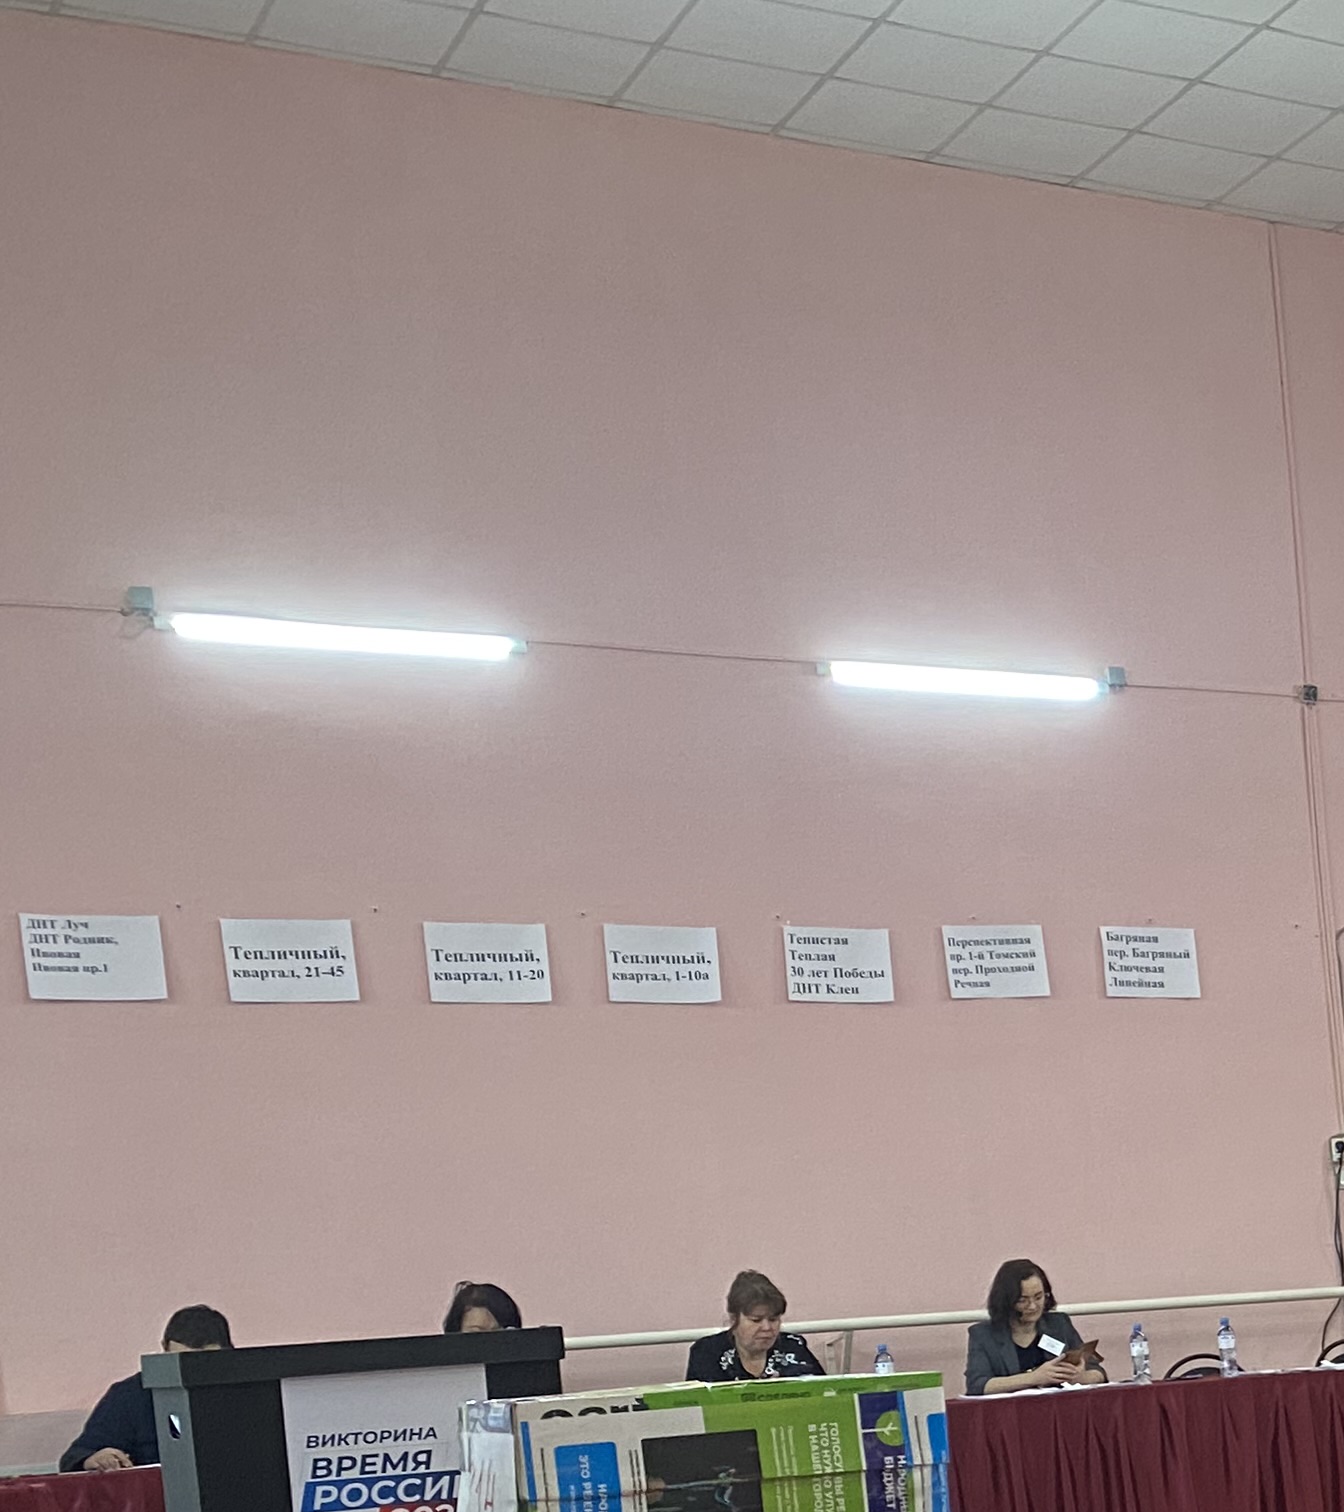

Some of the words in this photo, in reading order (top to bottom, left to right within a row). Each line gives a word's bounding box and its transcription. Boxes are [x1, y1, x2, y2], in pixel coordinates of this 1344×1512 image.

[26, 918, 57, 929] ДНТ
[61, 919, 90, 932] Луч
[28, 933, 60, 945] ДНТ
[787, 933, 849, 946] Тенистая
[1106, 931, 1159, 945] Багряная
[228, 945, 347, 961] Тепличный,
[430, 948, 541, 963] Тепличный,
[609, 950, 712, 965] Тепличный,
[789, 949, 836, 962] Теплая
[986, 949, 1037, 960] Томский
[1107, 949, 1129, 960] пер.
[1132, 947, 1191, 961] Багряный
[232, 968, 301, 981] квартал,
[790, 966, 804, 978] 30
[807, 969, 829, 979] лет
[833, 967, 885, 980] Победы
[951, 967, 974, 977] пер.
[1108, 961, 1165, 974] Ключевая
[434, 972, 503, 985] квартал,
[508, 969, 545, 981] 11-20
[612, 972, 672, 984] квартал,
[674, 970, 710, 981] 1-10а
[1108, 977, 1165, 989] Линейная
[791, 982, 822, 995] ДНТ
[825, 983, 860, 995] Клен
[808, 1424, 816, 1432] В
[819, 1423, 829, 1447] ЧТО
[305, 1426, 438, 1449] ВИКТОРИНА
[310, 1449, 433, 1480] ВРЕМЯ
[578, 1455, 590, 1478] ЭТО
